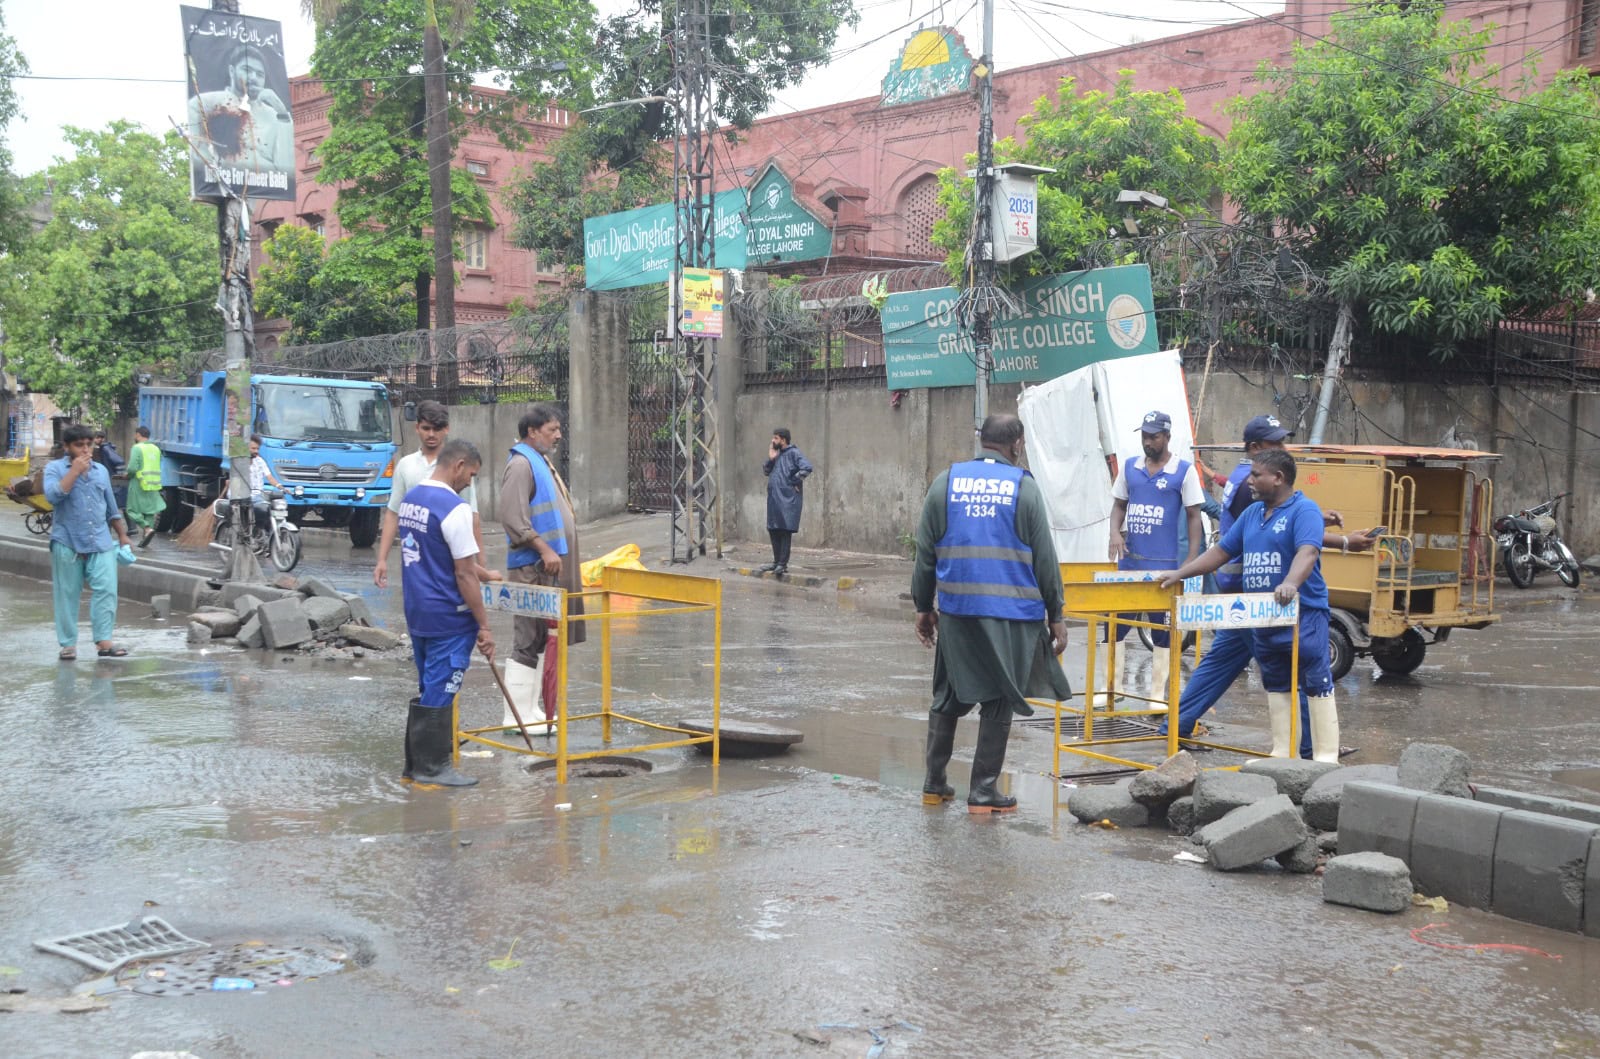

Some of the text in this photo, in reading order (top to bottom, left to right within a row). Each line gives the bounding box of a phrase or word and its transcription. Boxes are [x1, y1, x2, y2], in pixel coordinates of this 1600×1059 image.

[231, 166, 245, 185] For
[268, 170, 288, 190] Balaj
[1009, 197, 1034, 214] 2031
[759, 226, 783, 242] DYAL
[784, 221, 815, 239] SINGH
[1015, 220, 1029, 236] 15
[586, 231, 609, 259] Govt.
[609, 224, 631, 262] Dyal
[631, 218, 661, 254] Singh
[773, 240, 804, 254] LAHORE
[642, 256, 669, 272] Lahore
[1036, 282, 1105, 318] SINGH
[937, 327, 1020, 356] GRAATE
[1022, 321, 1097, 348] COLLEGE
[993, 355, 1040, 373] LAHORE
[952, 476, 1015, 496] WASA
[950, 493, 1013, 506] LAHORE
[964, 504, 996, 518] 1334
[1128, 503, 1165, 519] WASA
[399, 518, 428, 534] AHORE
[1129, 523, 1152, 535] 1334
[1242, 566, 1282, 576] AHORE
[1245, 575, 1271, 589] 1334
[516, 590, 558, 614] LAHORE
[1180, 604, 1224, 623] WASA
